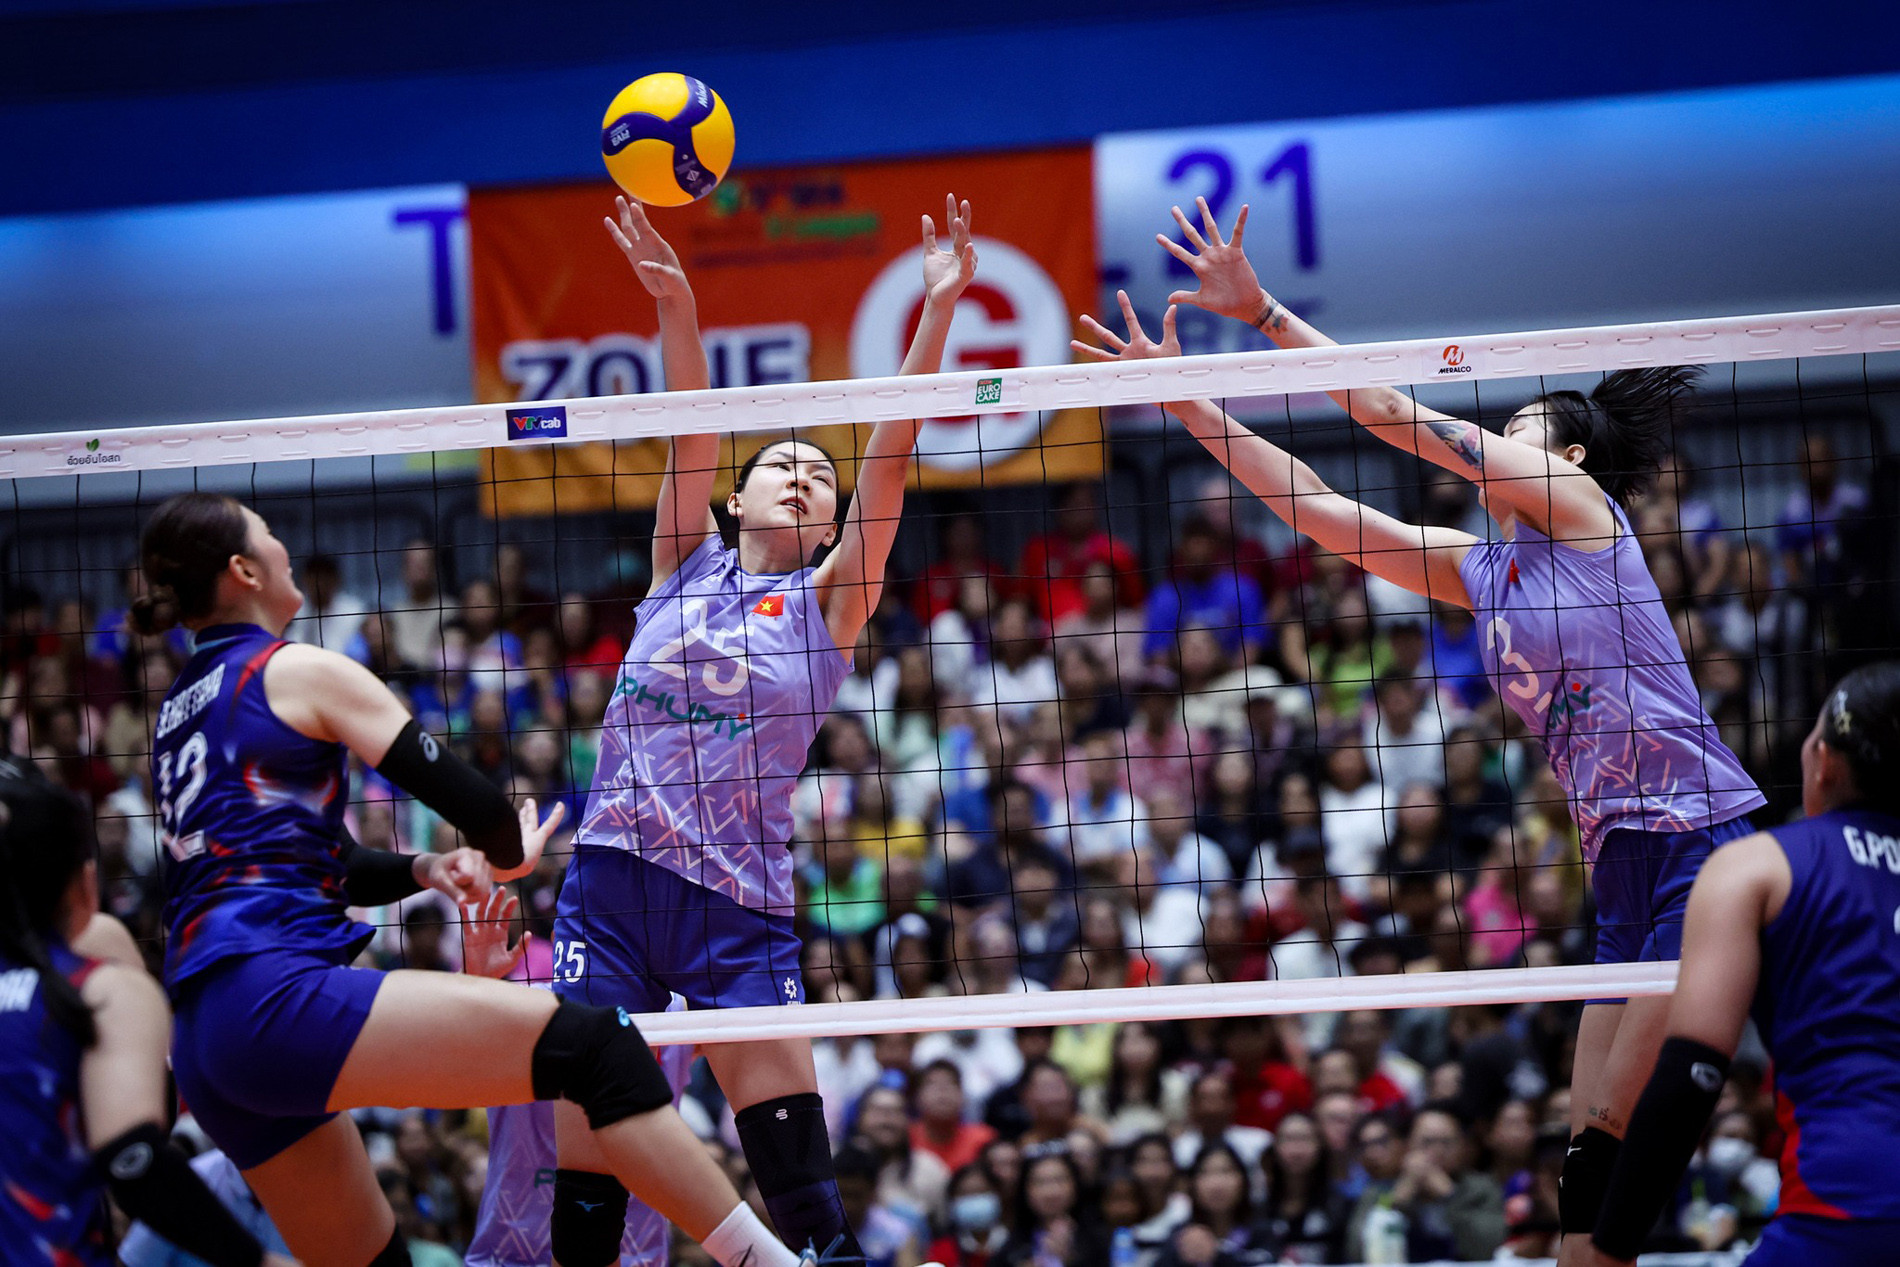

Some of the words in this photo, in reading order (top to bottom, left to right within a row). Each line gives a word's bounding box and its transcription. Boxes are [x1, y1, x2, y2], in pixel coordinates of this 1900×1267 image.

[1166, 141, 1319, 276] 21
[903, 282, 1021, 424] G
[1438, 366, 1472, 374] MERALCO
[976, 391, 1000, 402] CAKE
[977, 383, 1001, 394] EURO
[513, 416, 562, 431] VTVcab
[648, 598, 755, 696] 25
[1486, 616, 1539, 699] 3
[553, 940, 586, 983] 25
